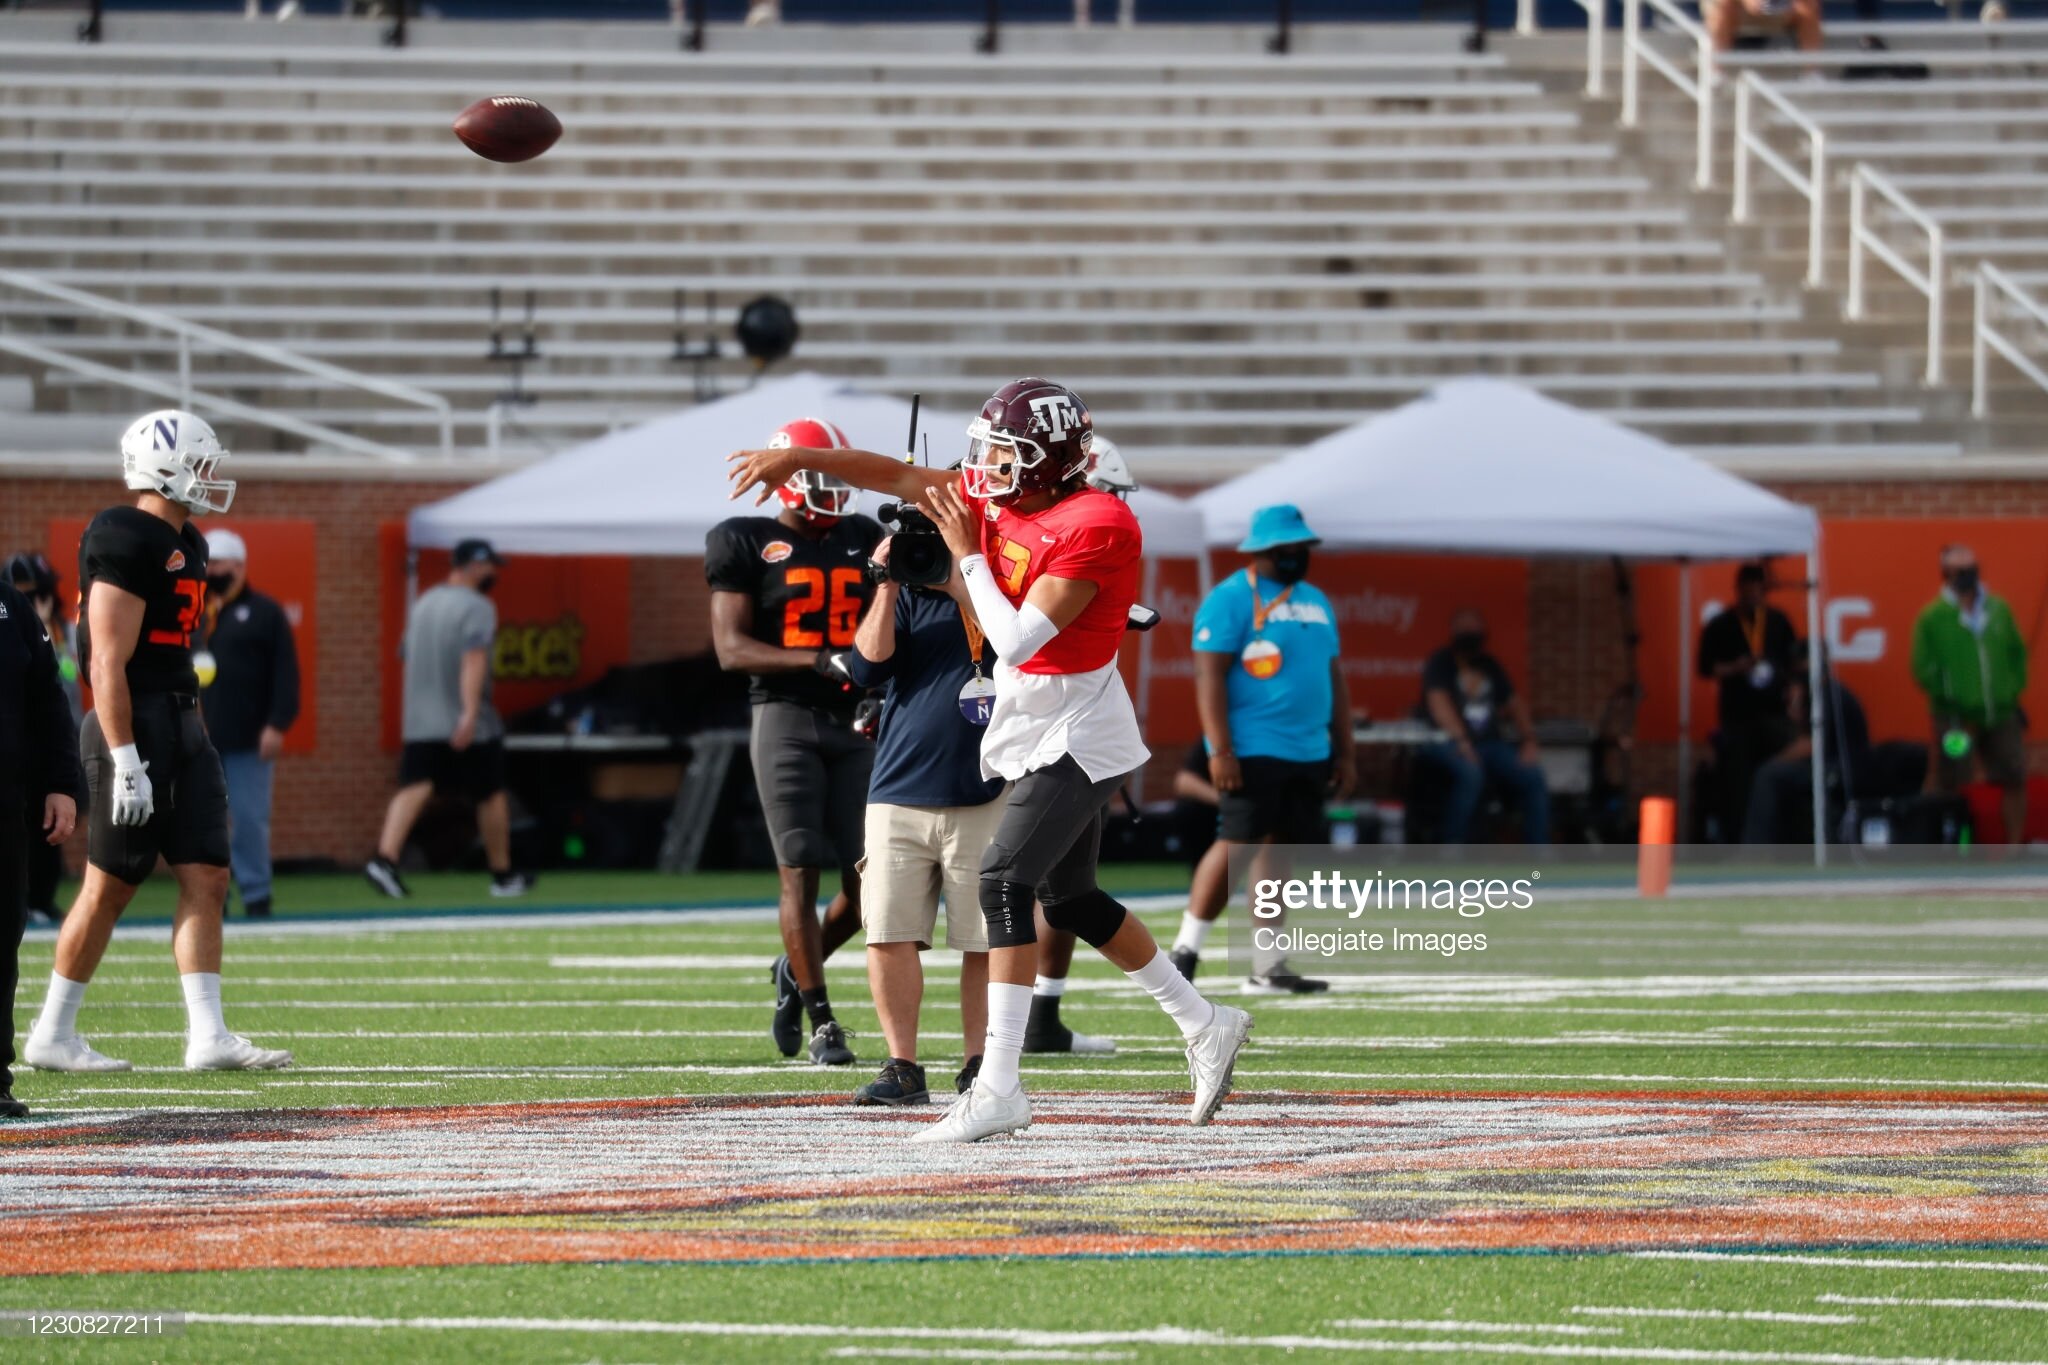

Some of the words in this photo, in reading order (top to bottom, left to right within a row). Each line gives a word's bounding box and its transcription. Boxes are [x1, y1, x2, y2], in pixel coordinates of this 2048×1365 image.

[153, 419, 178, 451] N
[783, 567, 862, 647] 26
[977, 704, 990, 720] N
